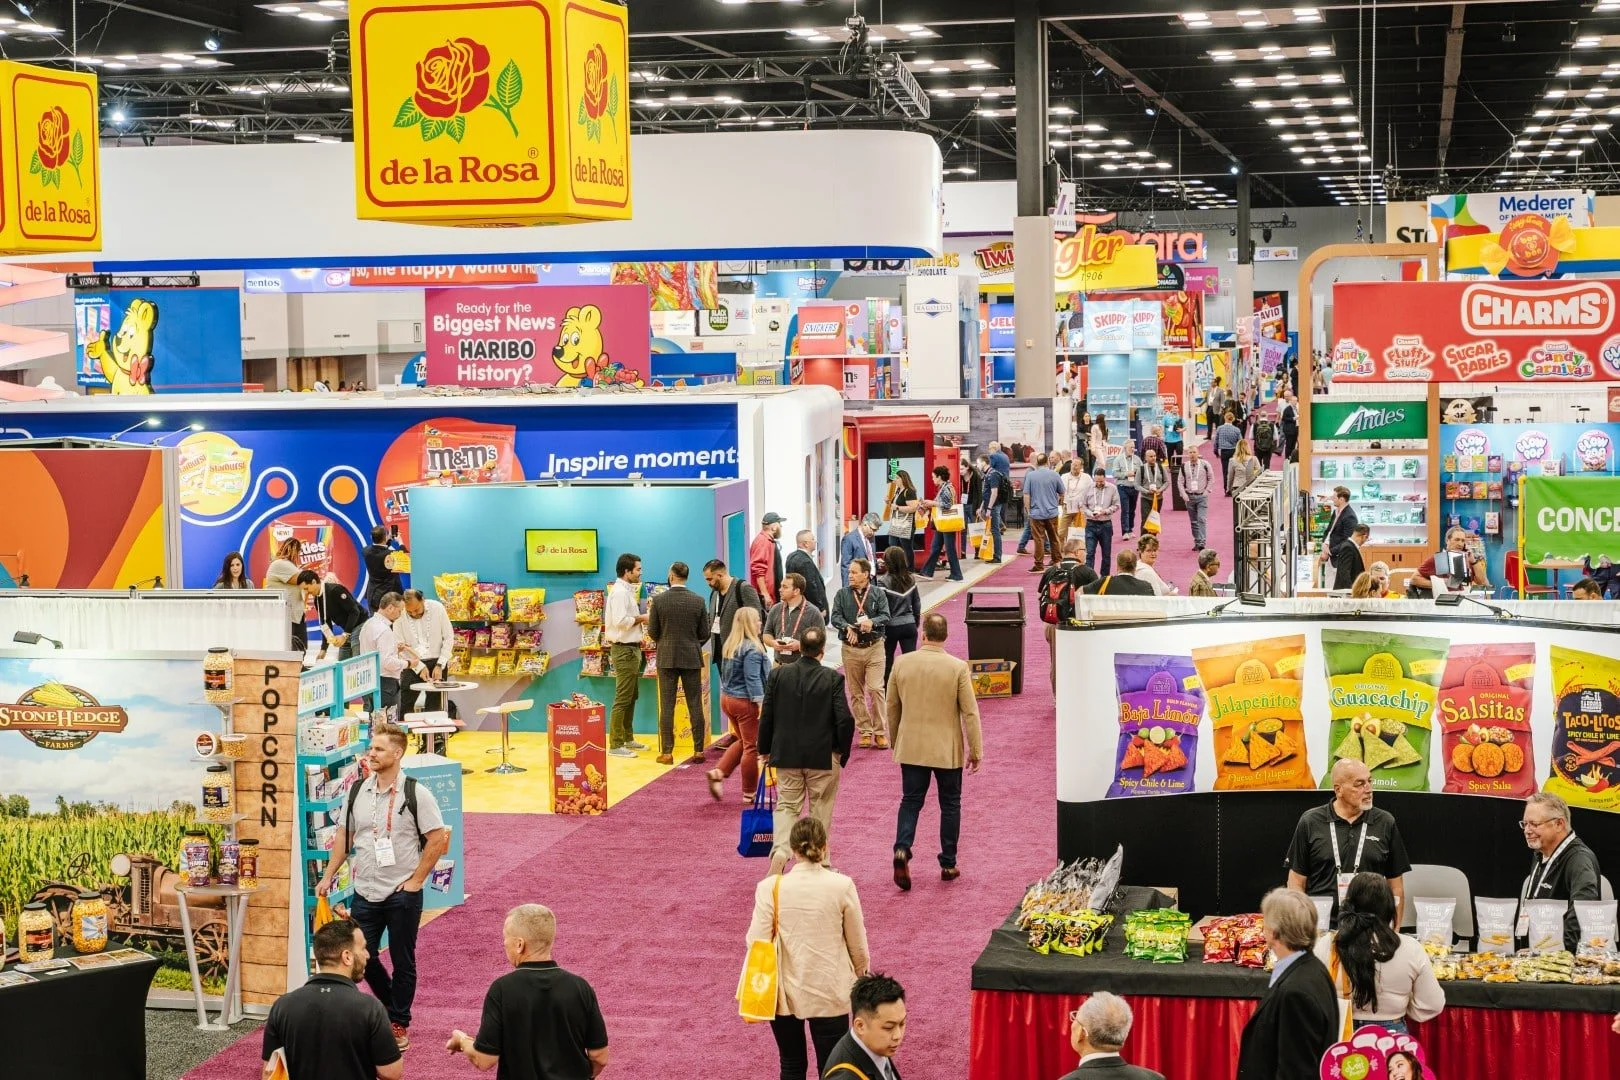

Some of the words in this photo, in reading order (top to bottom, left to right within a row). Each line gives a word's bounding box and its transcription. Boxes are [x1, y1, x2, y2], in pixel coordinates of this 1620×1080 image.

[380, 159, 418, 185] de
[423, 158, 451, 183] la
[459, 157, 539, 183] Rosa
[575, 156, 588, 182] de
[589, 158, 599, 184] la
[600, 159, 625, 188] Rosa
[1500, 194, 1575, 212] Mederer
[25, 200, 41, 222] de
[43, 201, 56, 222] la
[58, 201, 91, 225] Rosa
[1081, 271, 1103, 281] 1906
[456, 303, 491, 315] Ready
[495, 302, 510, 313] for
[513, 302, 532, 313] the
[1472, 293, 1601, 325] CHARMS
[433, 315, 502, 335] Biggest
[506, 315, 556, 332] News
[1094, 313, 1127, 328] SKIPPY
[1133, 312, 1155, 325] KIPPY
[804, 323, 838, 332] SNICKERS
[444, 343, 455, 354] in
[459, 339, 535, 360] HARIBO
[1335, 348, 1367, 363] Candy
[1387, 347, 1431, 363] Fluffy
[1445, 342, 1494, 365] SUGAR
[1395, 359, 1420, 367] Stuff
[1457, 351, 1509, 379] BABIES
[1531, 350, 1585, 366] Candy
[457, 363, 533, 385] History?
[1334, 361, 1373, 373] arnival
[1521, 362, 1592, 377] Carnival
[1345, 407, 1405, 434] Andes
[1455, 435, 1487, 451] BLOW
[1515, 437, 1548, 453] BLOW
[1577, 437, 1610, 452] BLOW
[1523, 447, 1545, 460] POP
[549, 450, 628, 477] Inspire
[1331, 687, 1429, 719] Guacachip
[1479, 692, 1510, 700] ORIGINAL
[1119, 702, 1149, 725] Baja
[1153, 699, 1200, 726] Limón
[1212, 692, 1298, 720] Jalapeñitos
[1440, 696, 1525, 723] Salsitas
[1582, 731, 1599, 739] CHILE
[45, 741, 74, 749] FARMS
[1119, 777, 1139, 789] Spicy
[1140, 778, 1159, 787] Chile
[1168, 780, 1184, 788] Lime
[1229, 773, 1253, 782] Queso
[1264, 769, 1295, 781] Jalapeño
[1468, 780, 1491, 791] Spicy
[1493, 780, 1512, 790] Salsa
